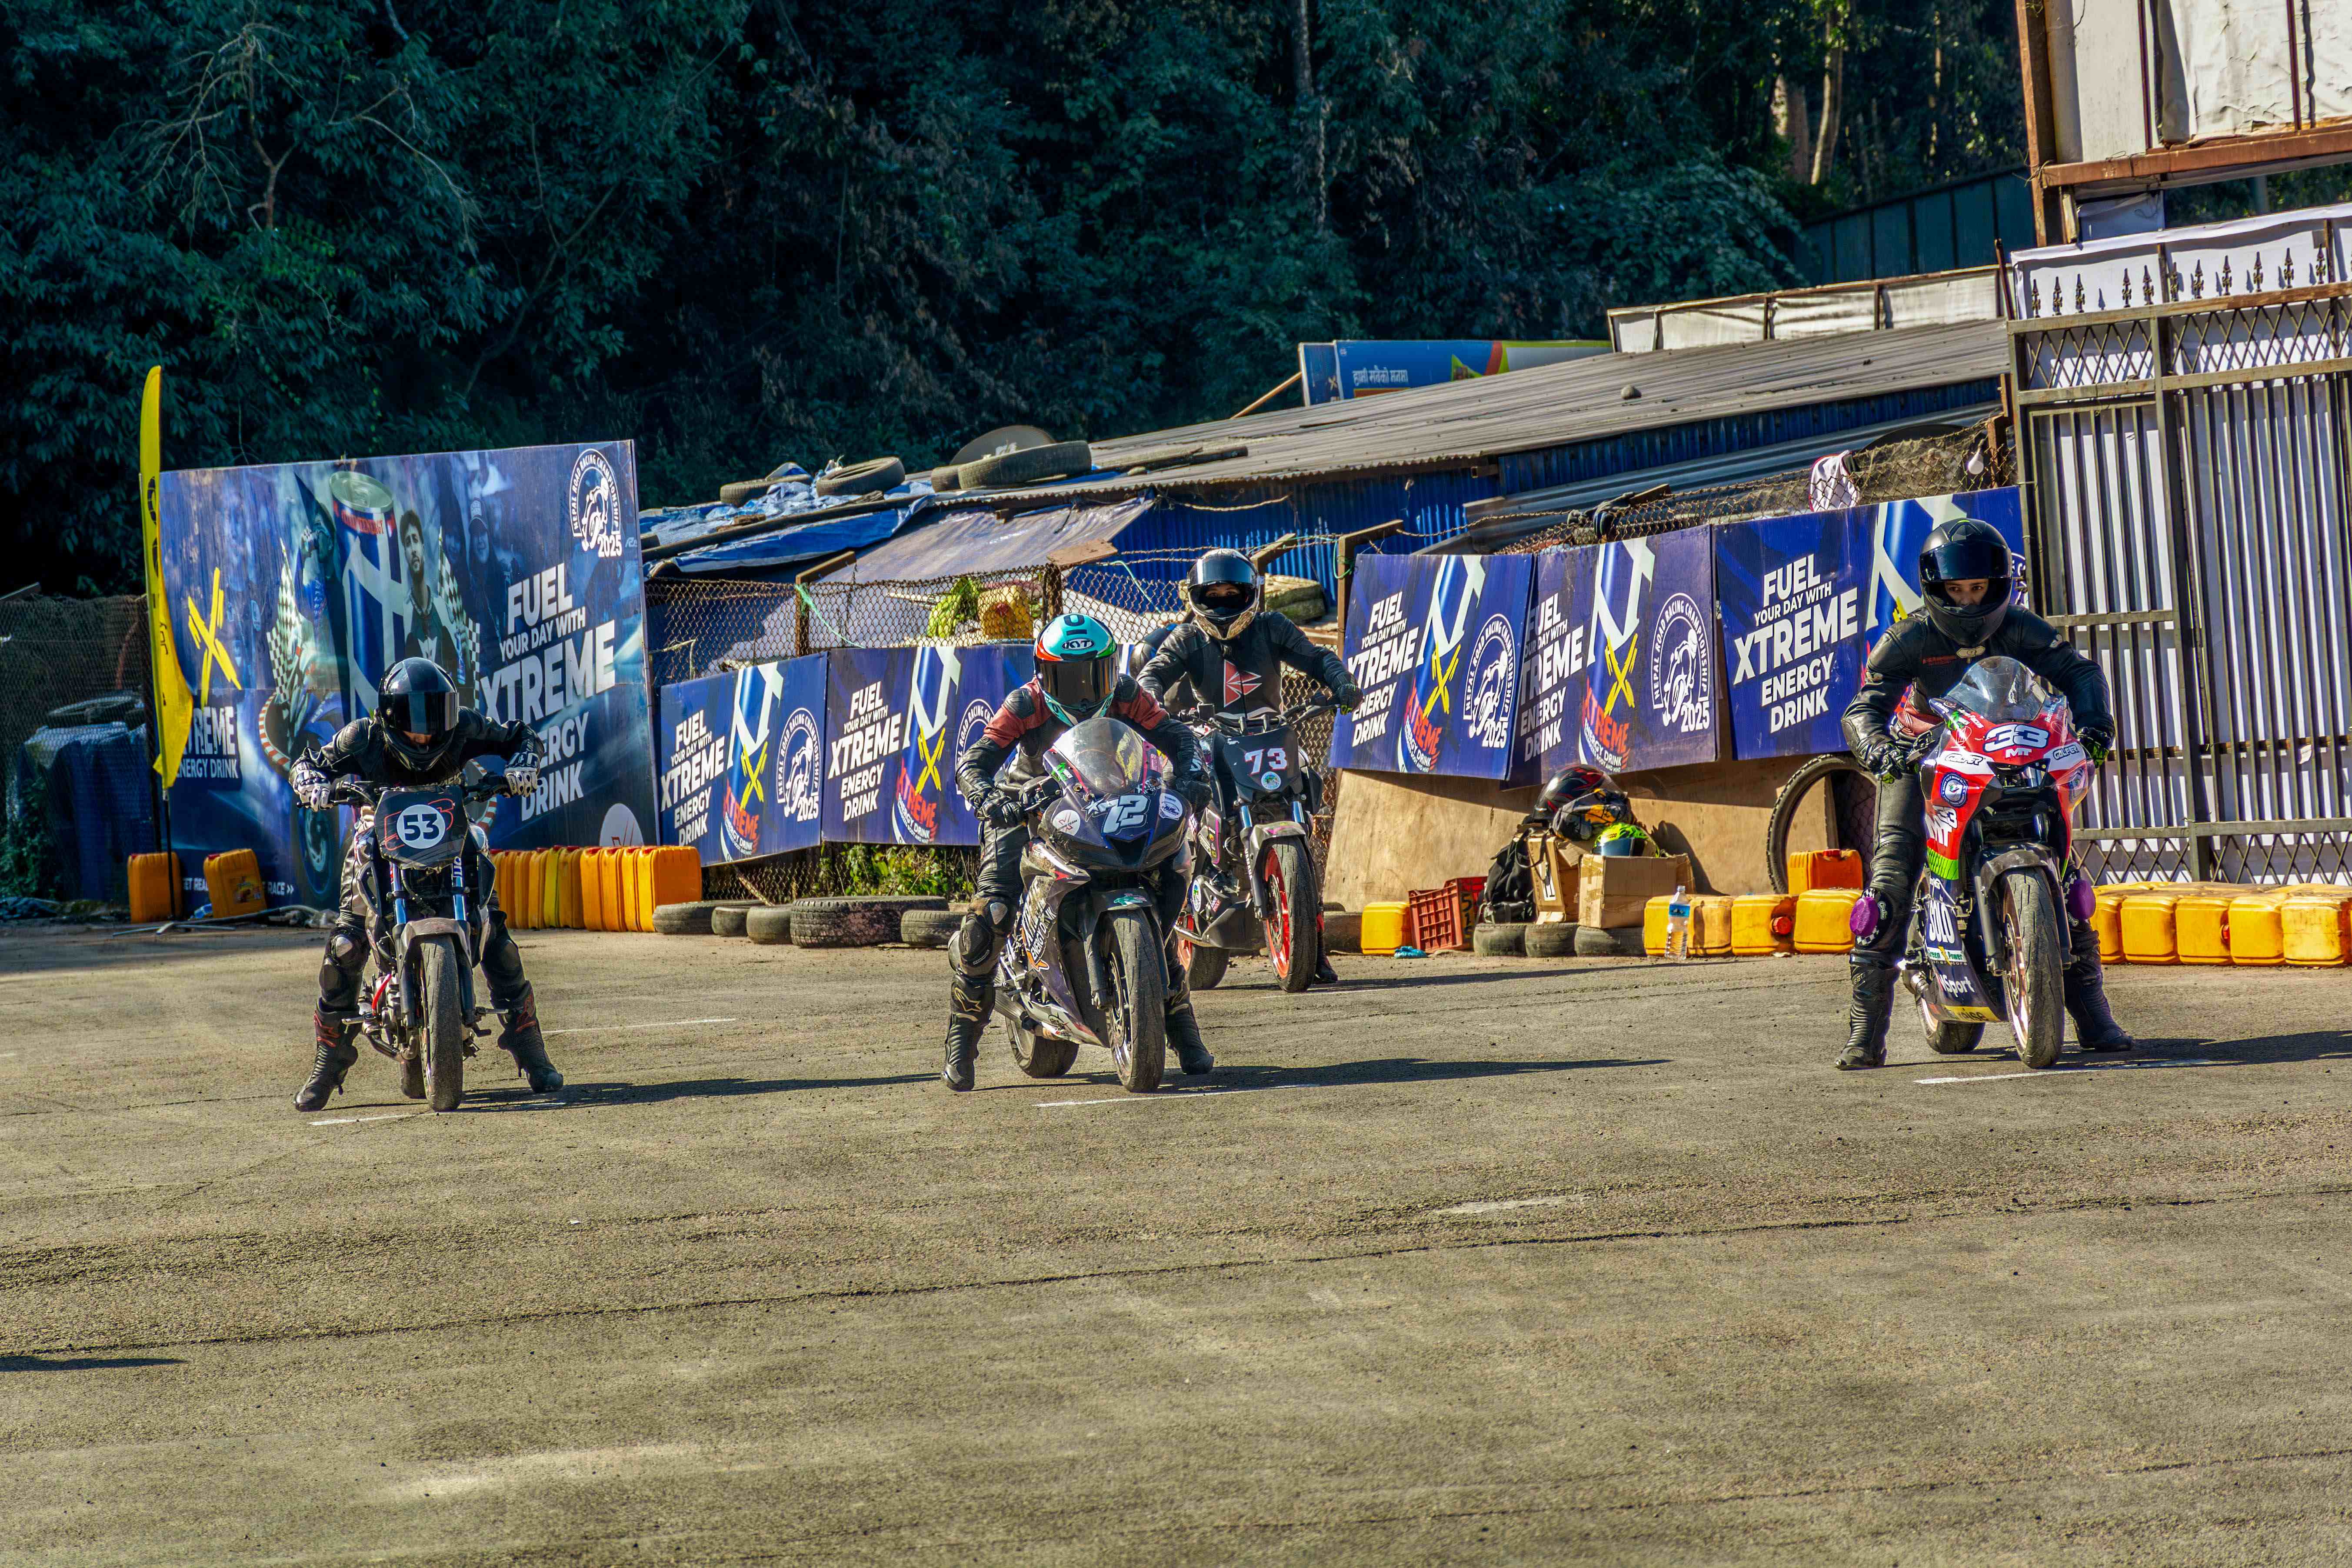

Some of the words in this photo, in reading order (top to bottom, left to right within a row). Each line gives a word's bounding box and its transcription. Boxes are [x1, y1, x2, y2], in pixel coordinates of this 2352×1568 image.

[572, 469, 582, 494] ROAD
[579, 454, 596, 468] RACING
[597, 457, 619, 529] CHAMPIONSHIP
[597, 535, 622, 558] 2025
[507, 563, 573, 635] FUEL
[1763, 553, 1821, 607] FUEL
[1368, 591, 1403, 634] FUEL
[1526, 593, 1561, 642] FUEL
[1754, 603, 1781, 627] YOUR
[1783, 593, 1804, 617] DAY
[1805, 581, 1832, 605] WITH
[500, 633, 528, 662] YOUR
[531, 621, 554, 646] DAY
[556, 607, 586, 639] WITH
[1063, 639, 1092, 649] KYT
[1361, 633, 1377, 650] YOUR
[1377, 626, 1390, 644] DAY
[1390, 618, 1406, 637] WITH
[1524, 641, 1537, 658] OUR
[1537, 633, 1550, 650] DAY
[1550, 619, 1568, 642] WITH
[1656, 621, 1666, 653] ROAD
[1665, 599, 1686, 617] RACING
[1685, 601, 1709, 692] CHAMPIONSHIP
[1733, 587, 1858, 685] XTREME
[480, 619, 616, 727] XTREME
[1347, 627, 1419, 690] XTREME
[1466, 668, 1475, 711] NEPAL
[1472, 640, 1485, 667] ROAD
[1485, 620, 1502, 639] RACING
[1501, 621, 1514, 711] CHAMPIONSHIP
[1520, 625, 1584, 706] TREME
[1761, 652, 1834, 707] ENERGY
[843, 719, 860, 735] YOUR
[860, 713, 872, 729] DAY
[873, 705, 888, 723] WITH
[850, 681, 883, 720] FUEL
[1520, 686, 1566, 737] ENERGY
[1681, 702, 1710, 732] 2025
[1770, 685, 1829, 734] DRINK
[183, 706, 236, 755] REME
[539, 711, 589, 769] ERGY
[676, 709, 707, 752] FUEL
[827, 713, 901, 780] XTREME
[959, 718, 969, 747] ROAD
[968, 705, 984, 724] RACING
[1352, 712, 1389, 748] DRINK
[1482, 720, 1509, 749] 2025
[1525, 718, 1562, 762] DRINK
[1983, 724, 2049, 753] 33
[177, 759, 208, 778] NERGY
[210, 759, 239, 779] DRINK
[671, 749, 685, 767] YOUR
[685, 742, 697, 759] DAY
[697, 731, 712, 750] WITH
[780, 729, 790, 757] ROAD
[789, 713, 805, 732] RACING
[805, 714, 819, 789] CHAMPIONSHIP
[1244, 747, 1287, 777] 73
[1416, 749, 1432, 767] DRINK
[1604, 749, 1622, 766] DRINK
[2005, 748, 2034, 758] MT
[2052, 744, 2080, 761] GALFER
[522, 760, 584, 821] DRINK
[660, 736, 725, 813] XTREME
[841, 762, 885, 800] ENERGY
[674, 786, 712, 829] ENERGY
[797, 796, 819, 822] 2025
[843, 789, 879, 822] DRINK
[403, 813, 440, 842] 53
[679, 812, 708, 847] DRINK
[739, 837, 753, 851] DRINK
[914, 822, 930, 839] DRINK
[1929, 899, 1955, 944] SOLO
[1030, 926, 1045, 961] ENERGY
[1947, 952, 1962, 960] Power
